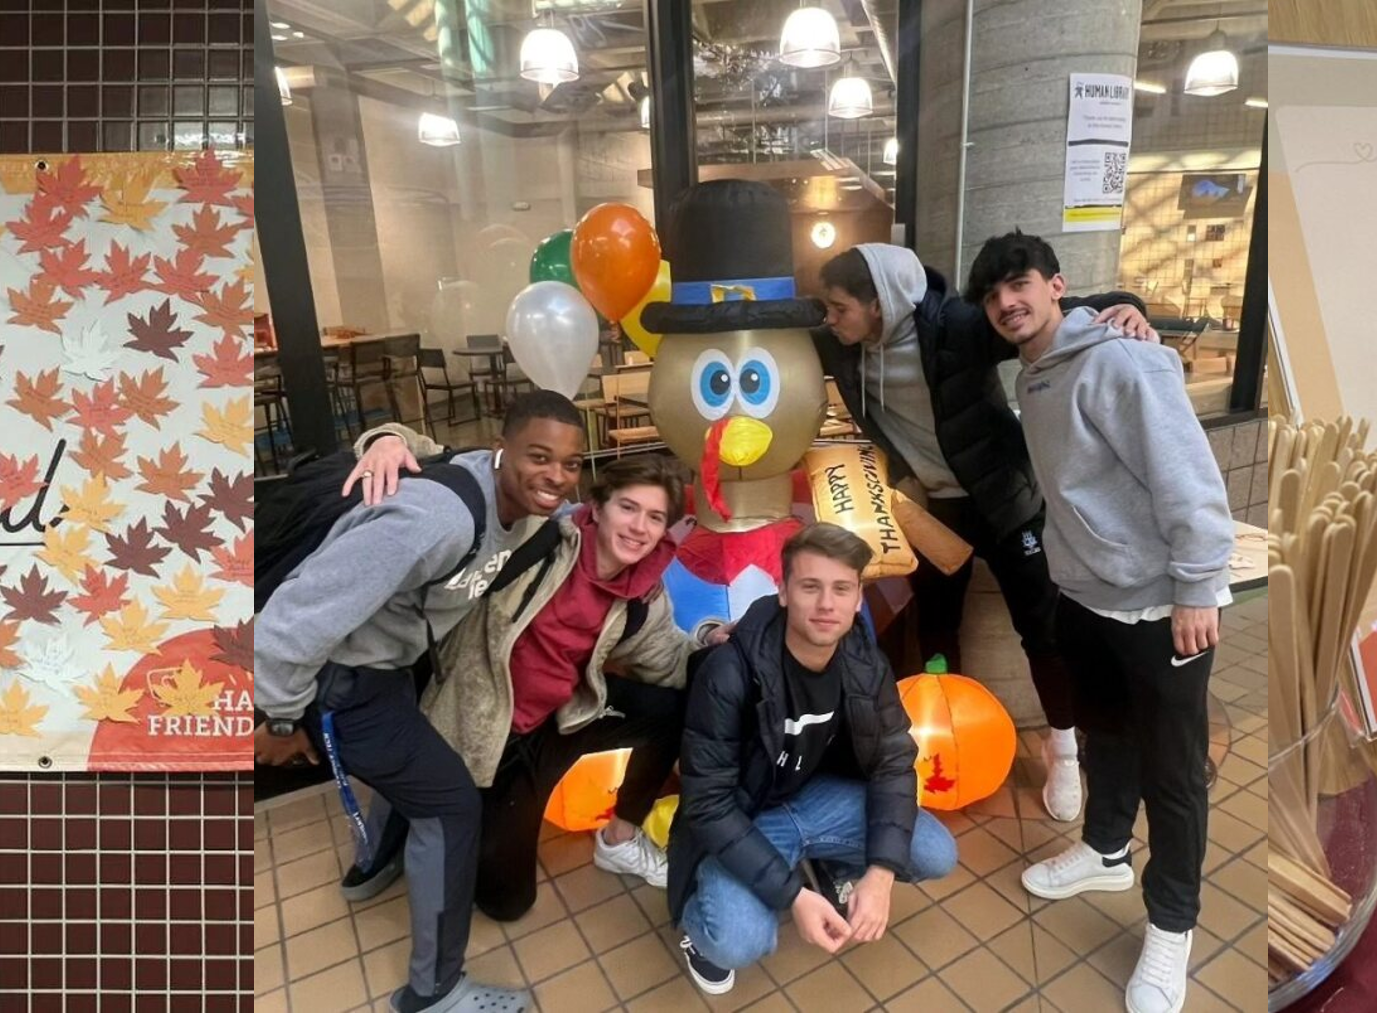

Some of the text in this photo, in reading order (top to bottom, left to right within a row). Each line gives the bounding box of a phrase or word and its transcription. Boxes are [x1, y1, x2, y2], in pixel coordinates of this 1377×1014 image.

[1085, 84, 1109, 98] HUMAN
[825, 464, 855, 514] HAPPY
[147, 714, 254, 737] FRIEND
